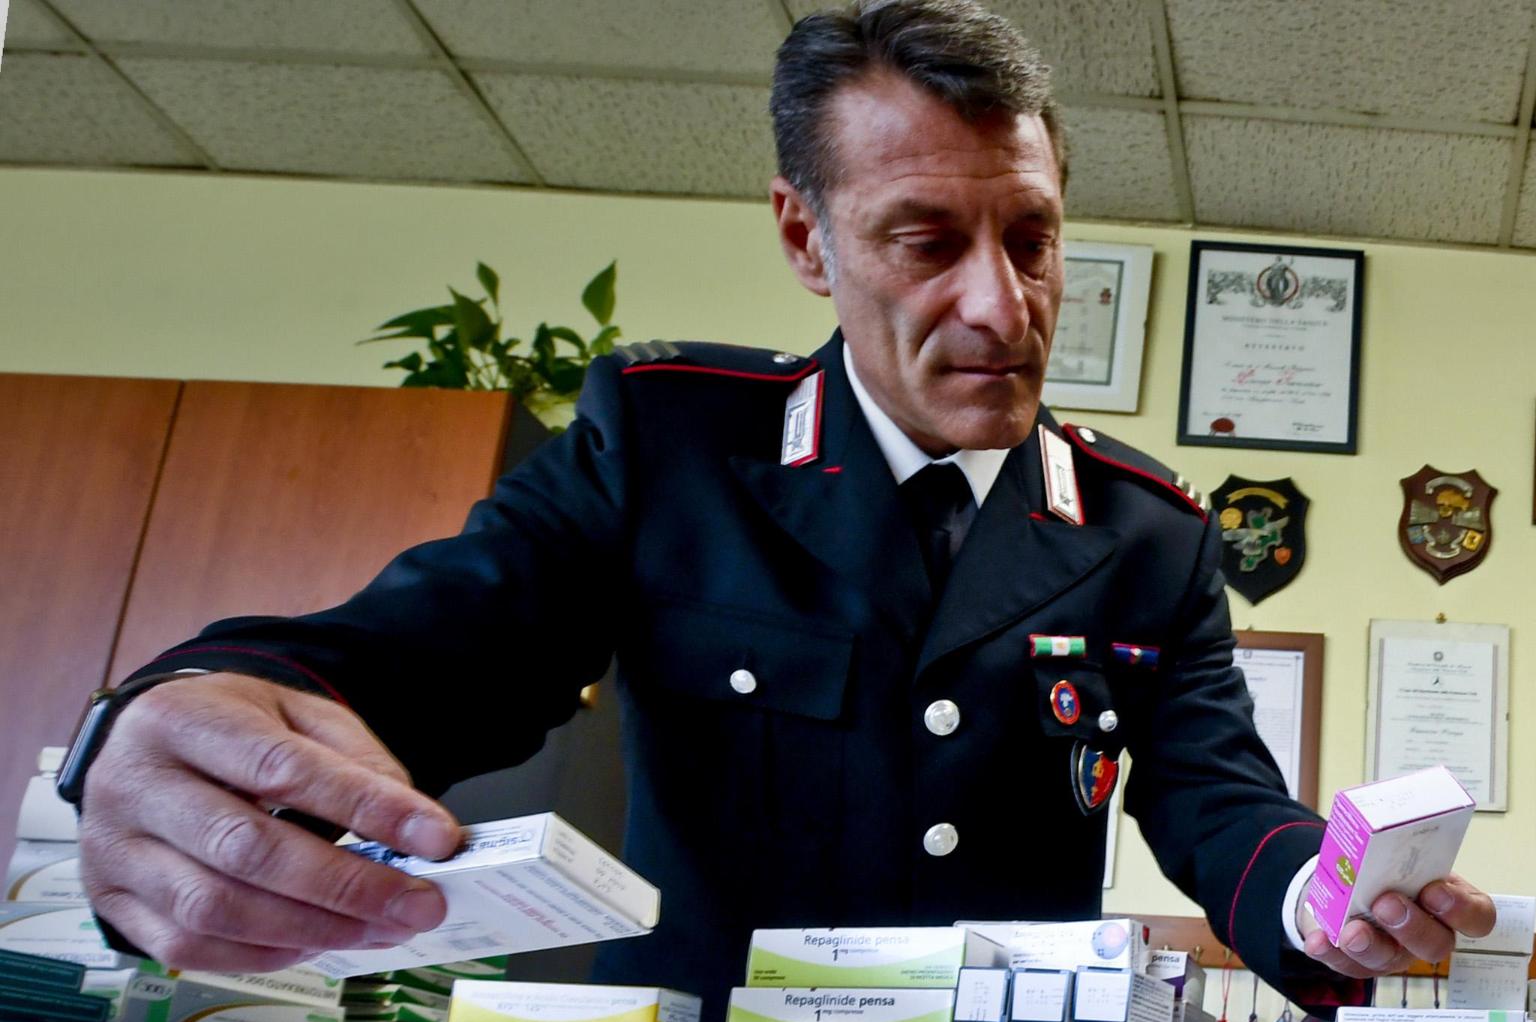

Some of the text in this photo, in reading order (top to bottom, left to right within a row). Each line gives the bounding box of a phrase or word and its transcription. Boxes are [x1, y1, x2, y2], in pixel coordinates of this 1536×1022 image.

[804, 935, 909, 947] Repaglinide pensa
[785, 995, 896, 1008] Repaglinide pensa
